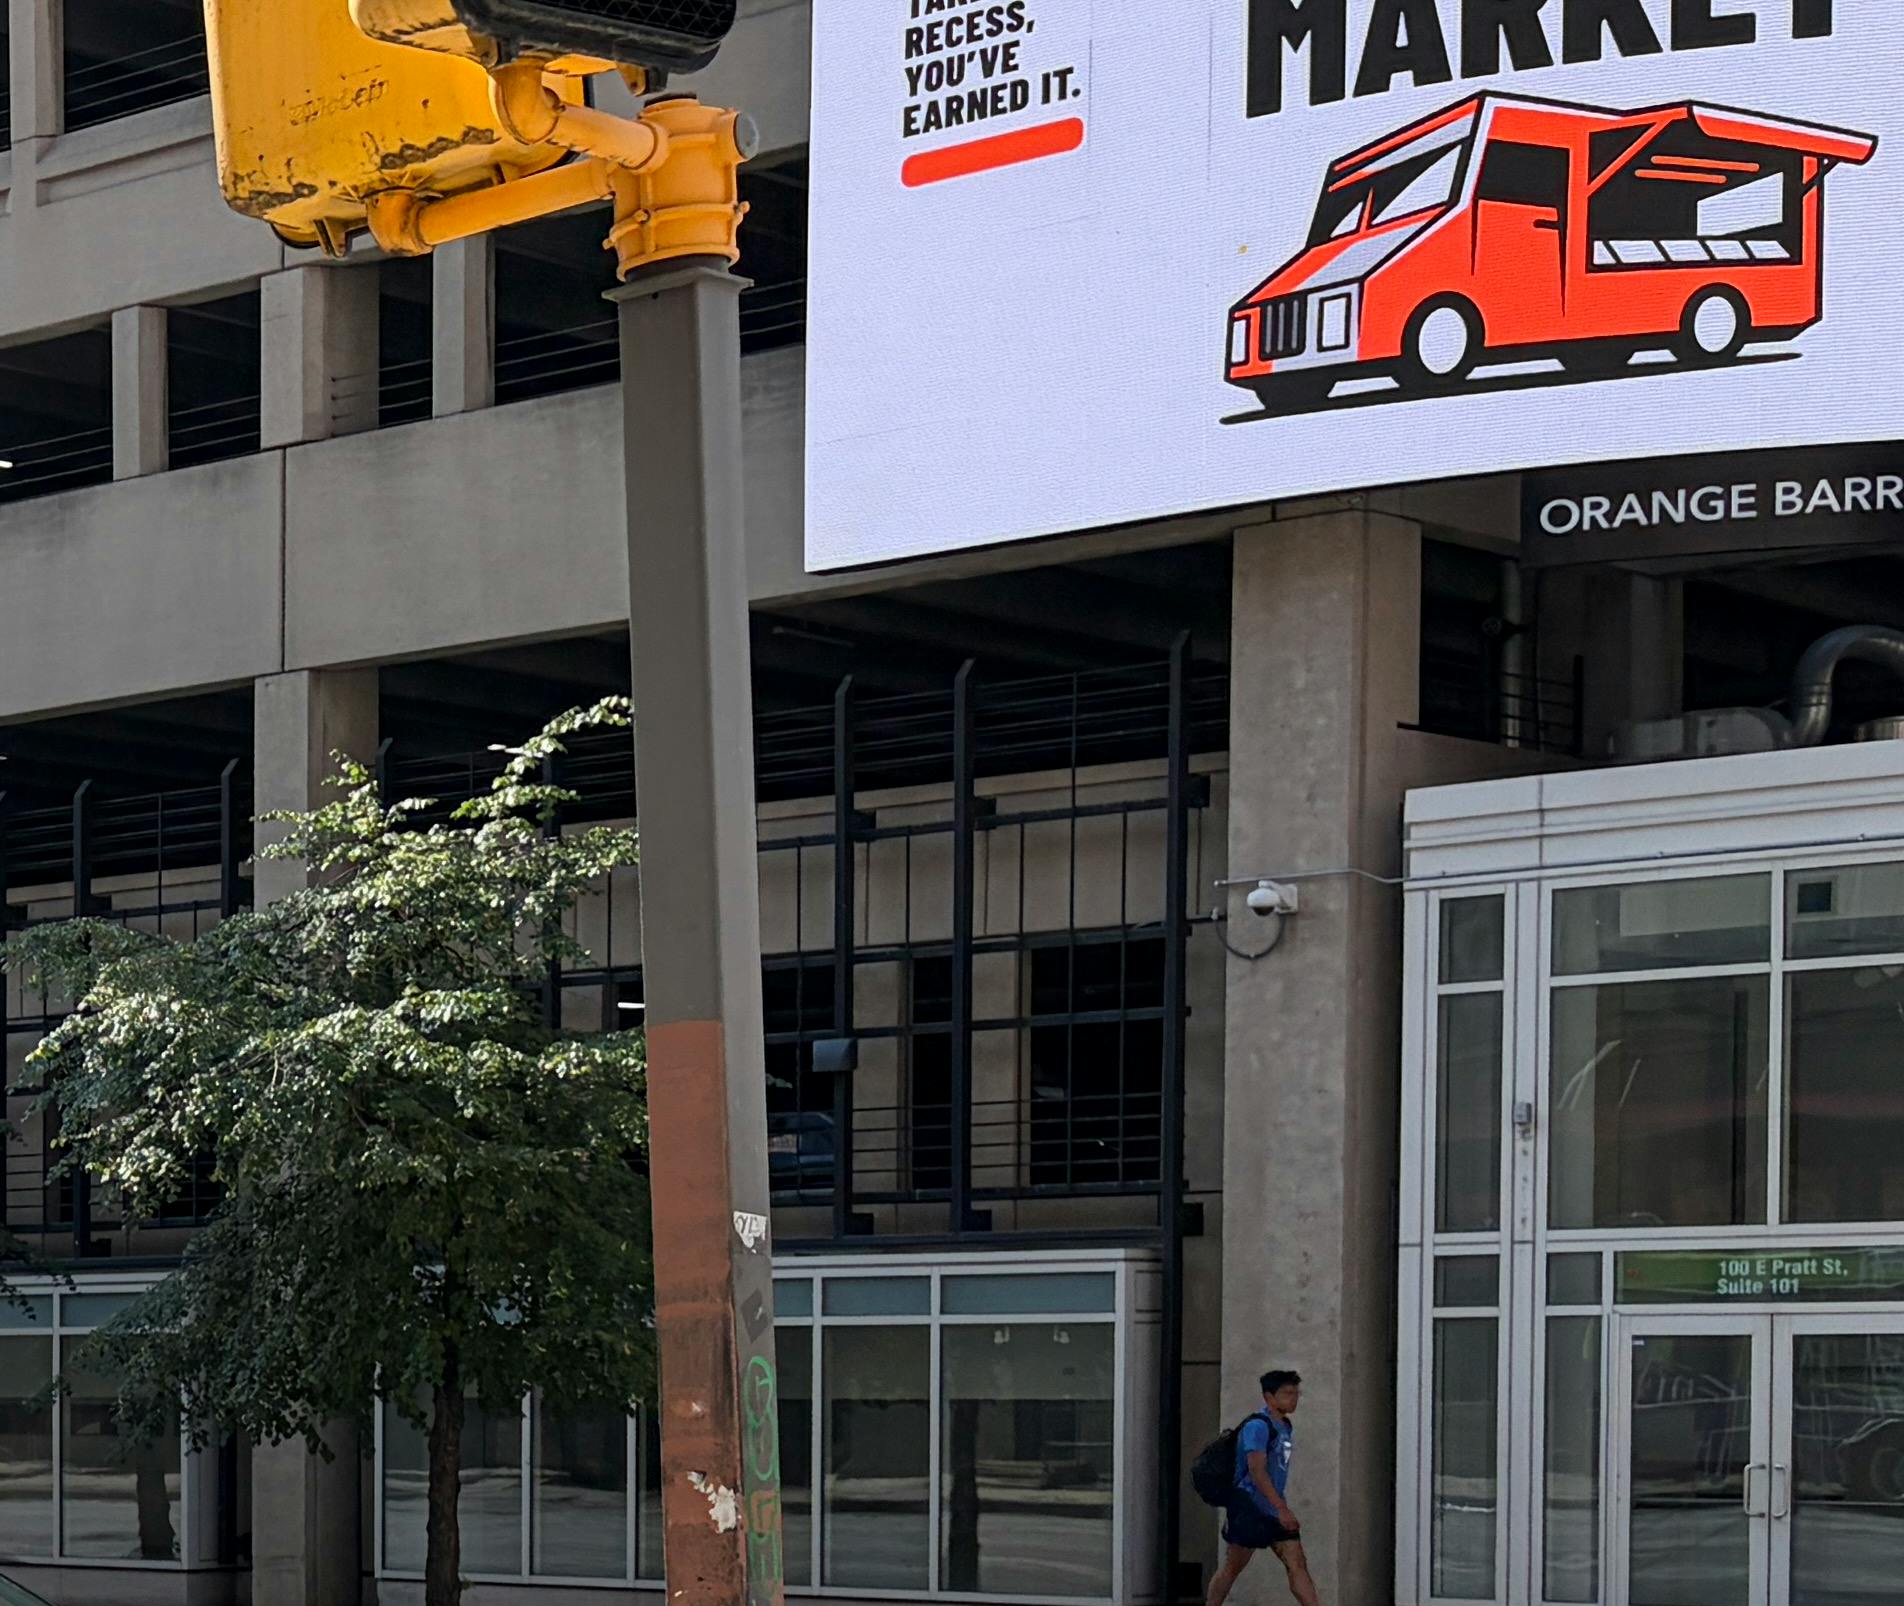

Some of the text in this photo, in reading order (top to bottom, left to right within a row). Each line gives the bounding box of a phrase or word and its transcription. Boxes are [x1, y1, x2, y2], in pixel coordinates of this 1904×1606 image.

[905, 1, 1035, 59] RECESS,
[905, 40, 1020, 97] YOU'VE
[903, 66, 1081, 138] EARNED IT.
[1540, 475, 1904, 534] ORANGE BARR
[1717, 1278, 1799, 1294] Suite 101
[1719, 1258, 1848, 1277] 100 E Pratt St,
